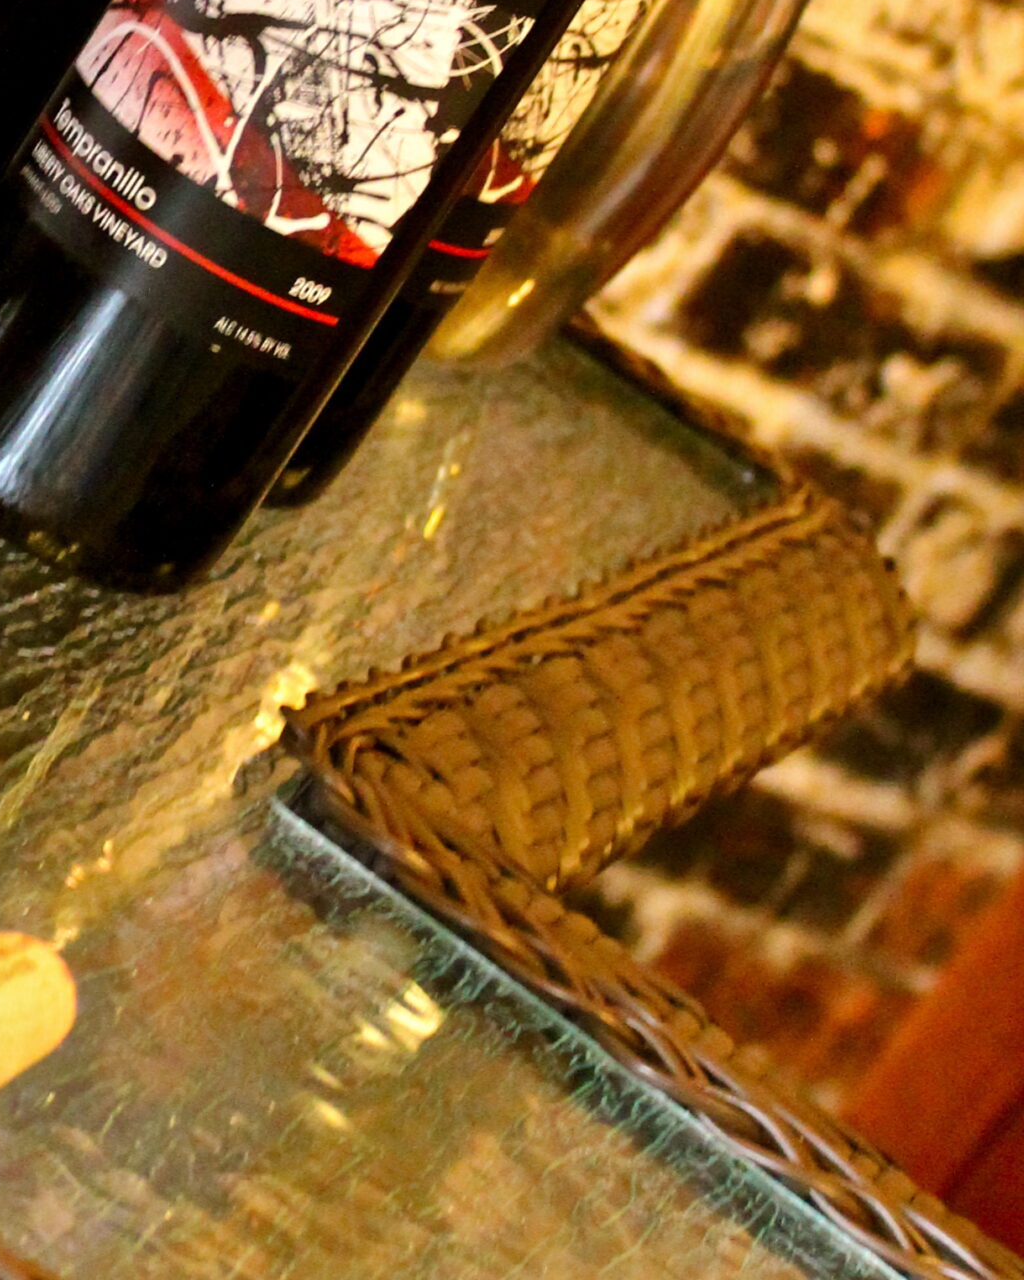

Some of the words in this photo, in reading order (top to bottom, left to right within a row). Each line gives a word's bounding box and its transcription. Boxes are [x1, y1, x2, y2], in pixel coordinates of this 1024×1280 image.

[54, 97, 157, 211] Tempranillo
[59, 174, 96, 215] OAKS
[93, 203, 168, 268] VINEYARD
[288, 276, 333, 306] 2009
